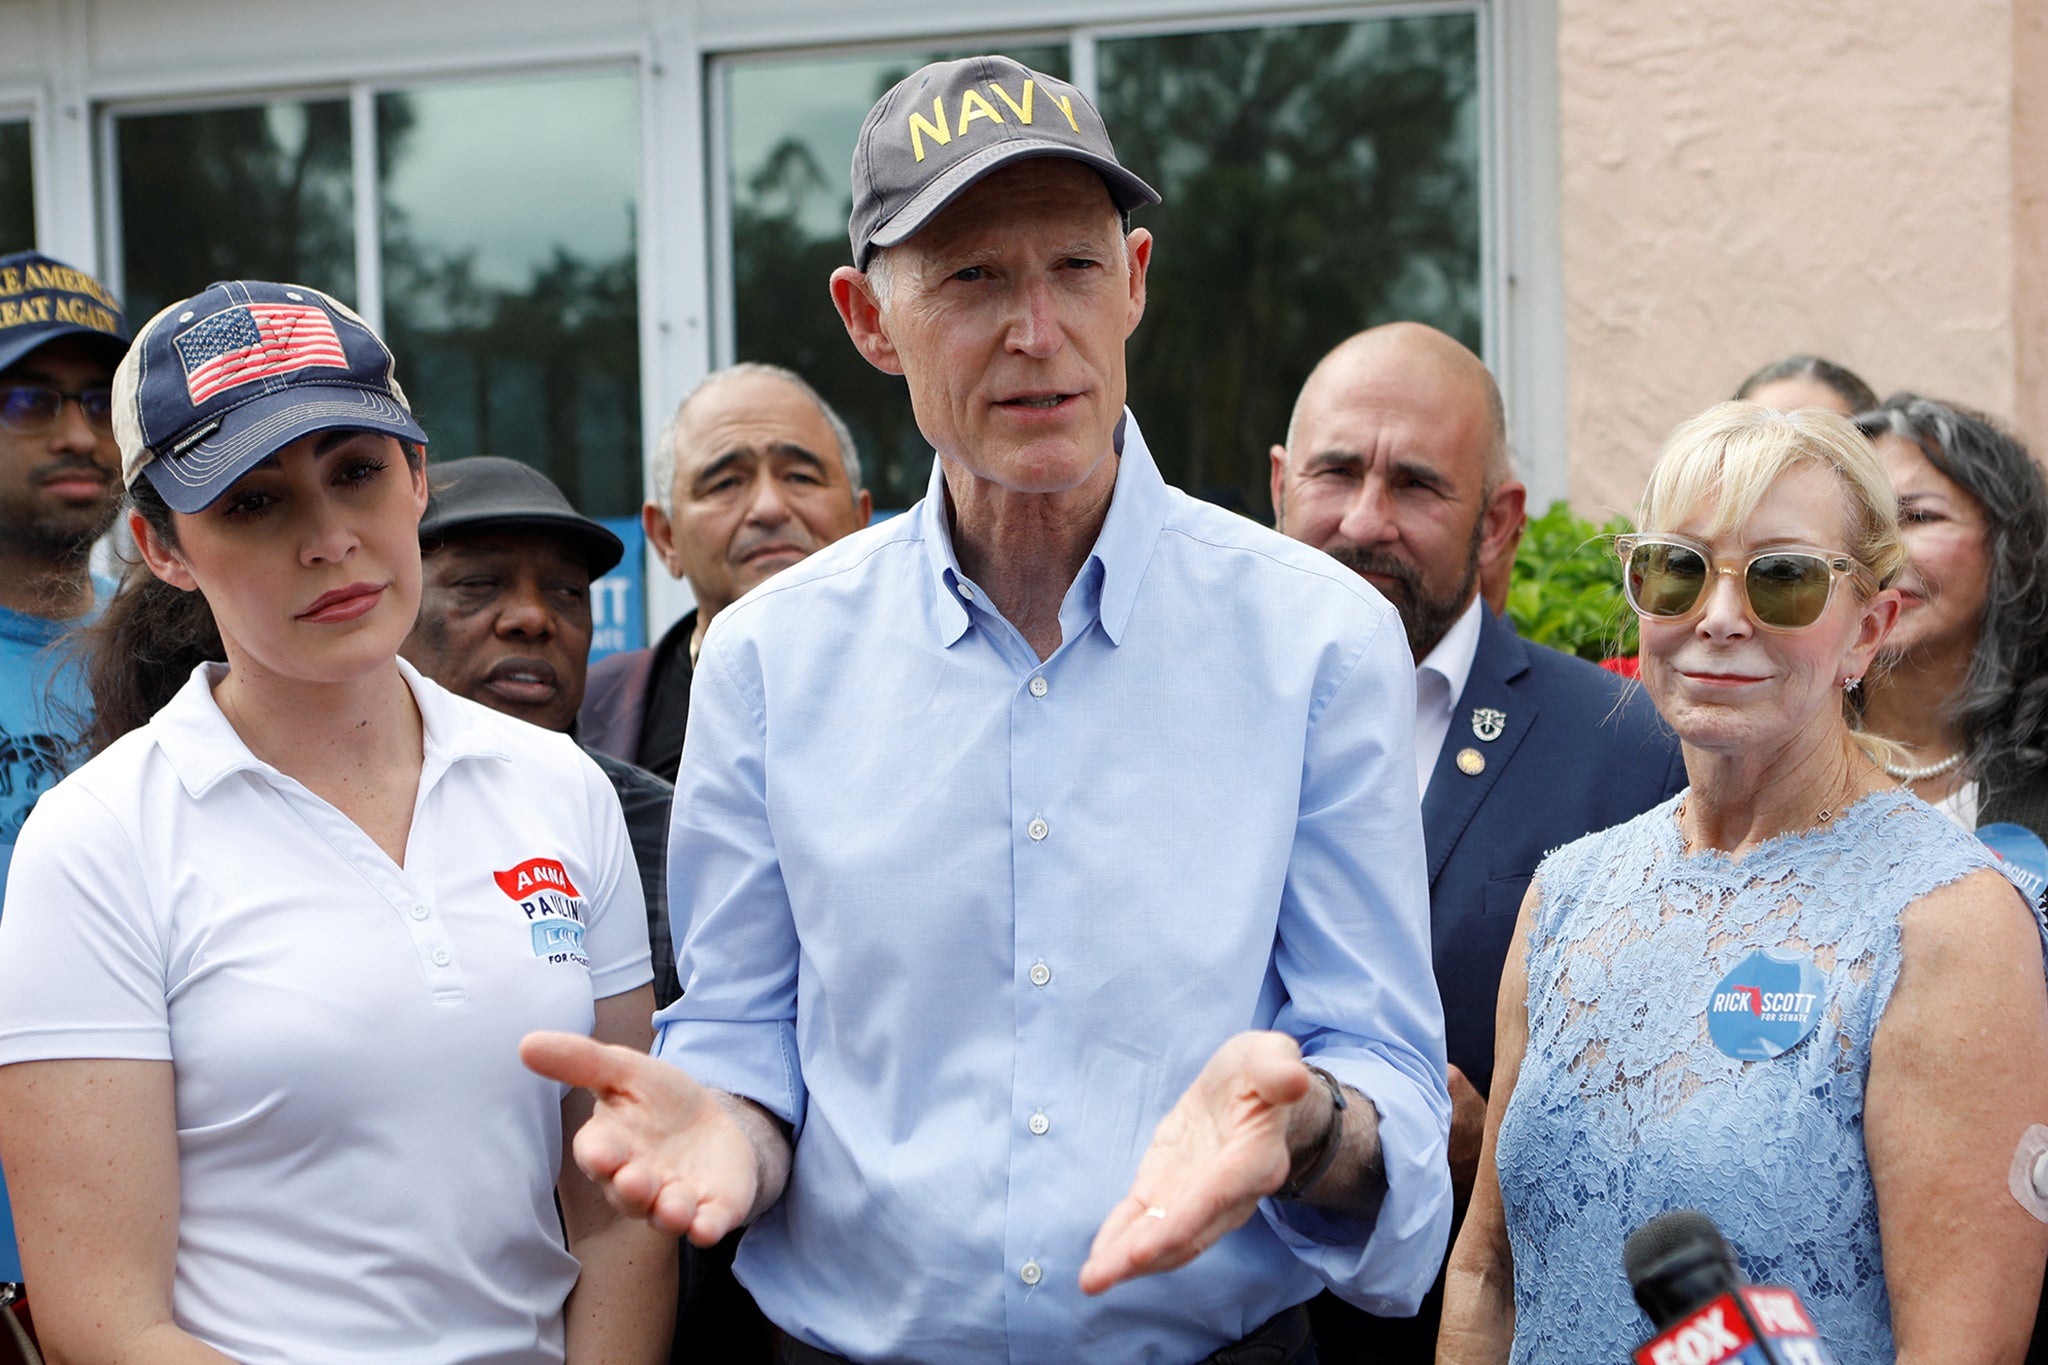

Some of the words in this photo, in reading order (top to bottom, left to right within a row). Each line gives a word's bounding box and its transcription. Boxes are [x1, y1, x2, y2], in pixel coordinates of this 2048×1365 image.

[908, 78, 1081, 163] NAVY
[0, 296, 50, 329] EAT
[517, 865, 567, 891] ANNA
[520, 895, 584, 923] PAULIN
[548, 953, 568, 965] FOR
[1713, 992, 1752, 1012] RICK
[1761, 992, 1816, 1013] SCOTT
[1761, 1013, 1775, 1022] FOR
[1778, 1013, 1809, 1023] SENATE
[1651, 1306, 1739, 1365] FOX
